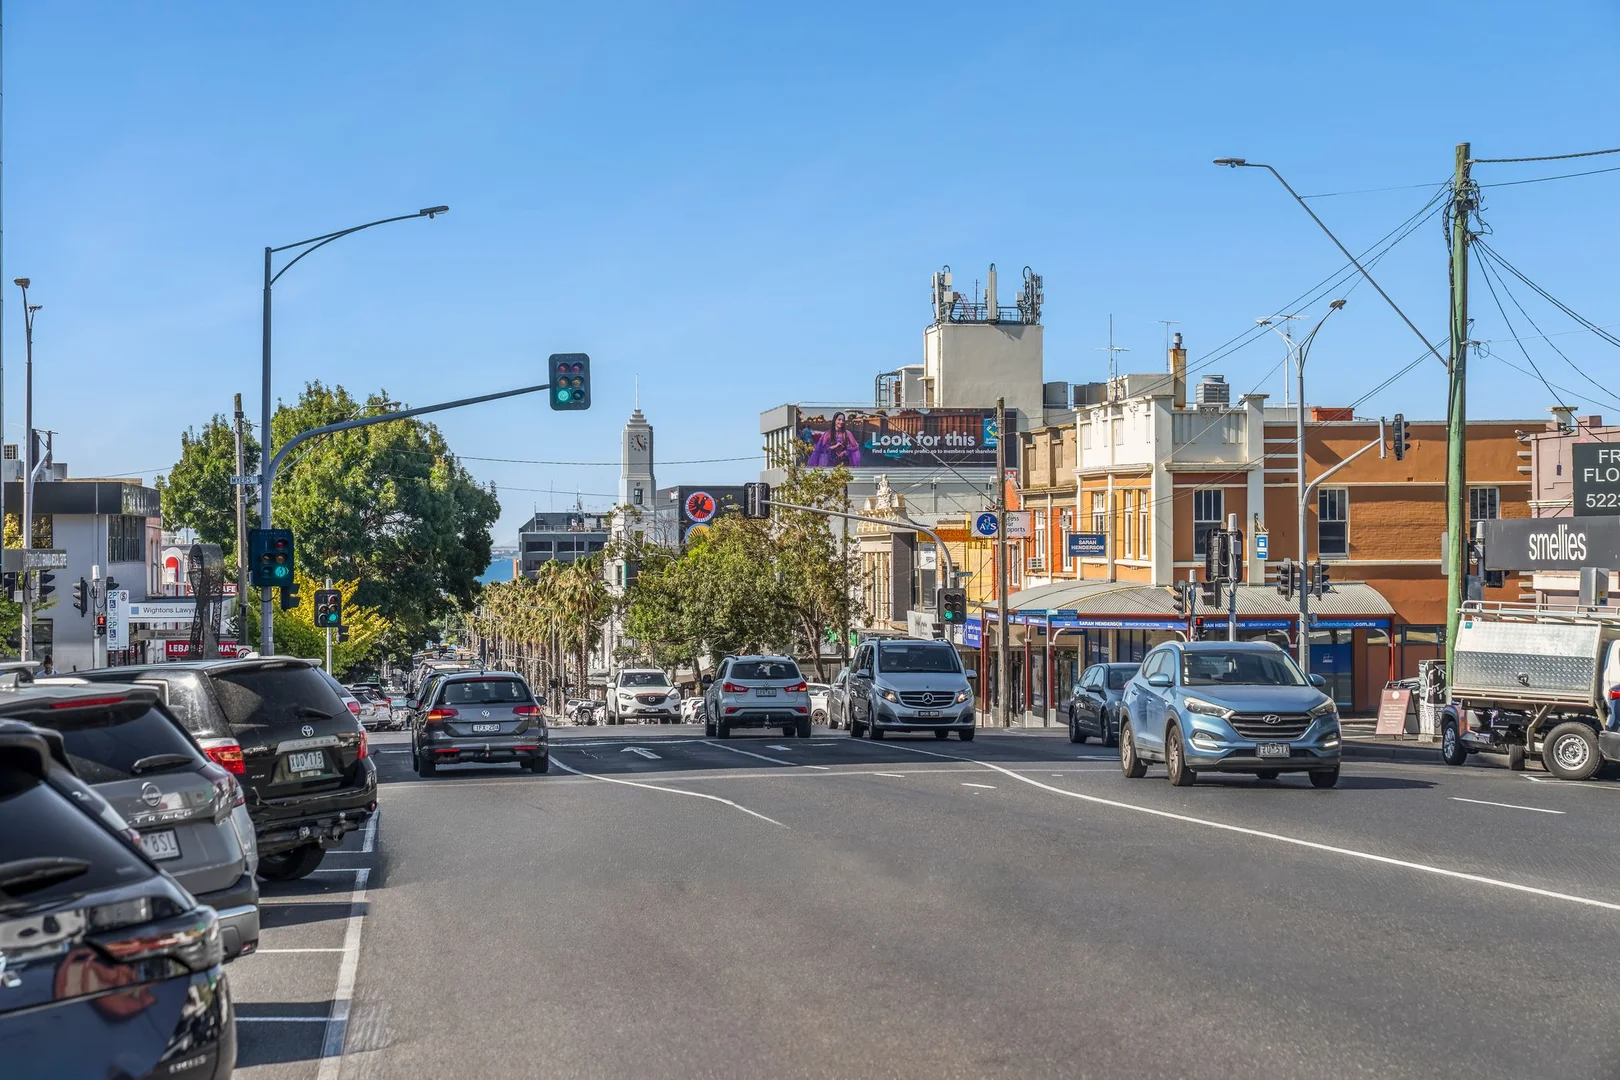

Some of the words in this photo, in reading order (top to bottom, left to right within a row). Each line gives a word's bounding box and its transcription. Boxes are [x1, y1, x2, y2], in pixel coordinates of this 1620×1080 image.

[872, 431, 912, 446] Look
[916, 431, 941, 446] for
[945, 431, 975, 446] this
[979, 522, 997, 530] AYS
[1528, 524, 1587, 560] smellies
